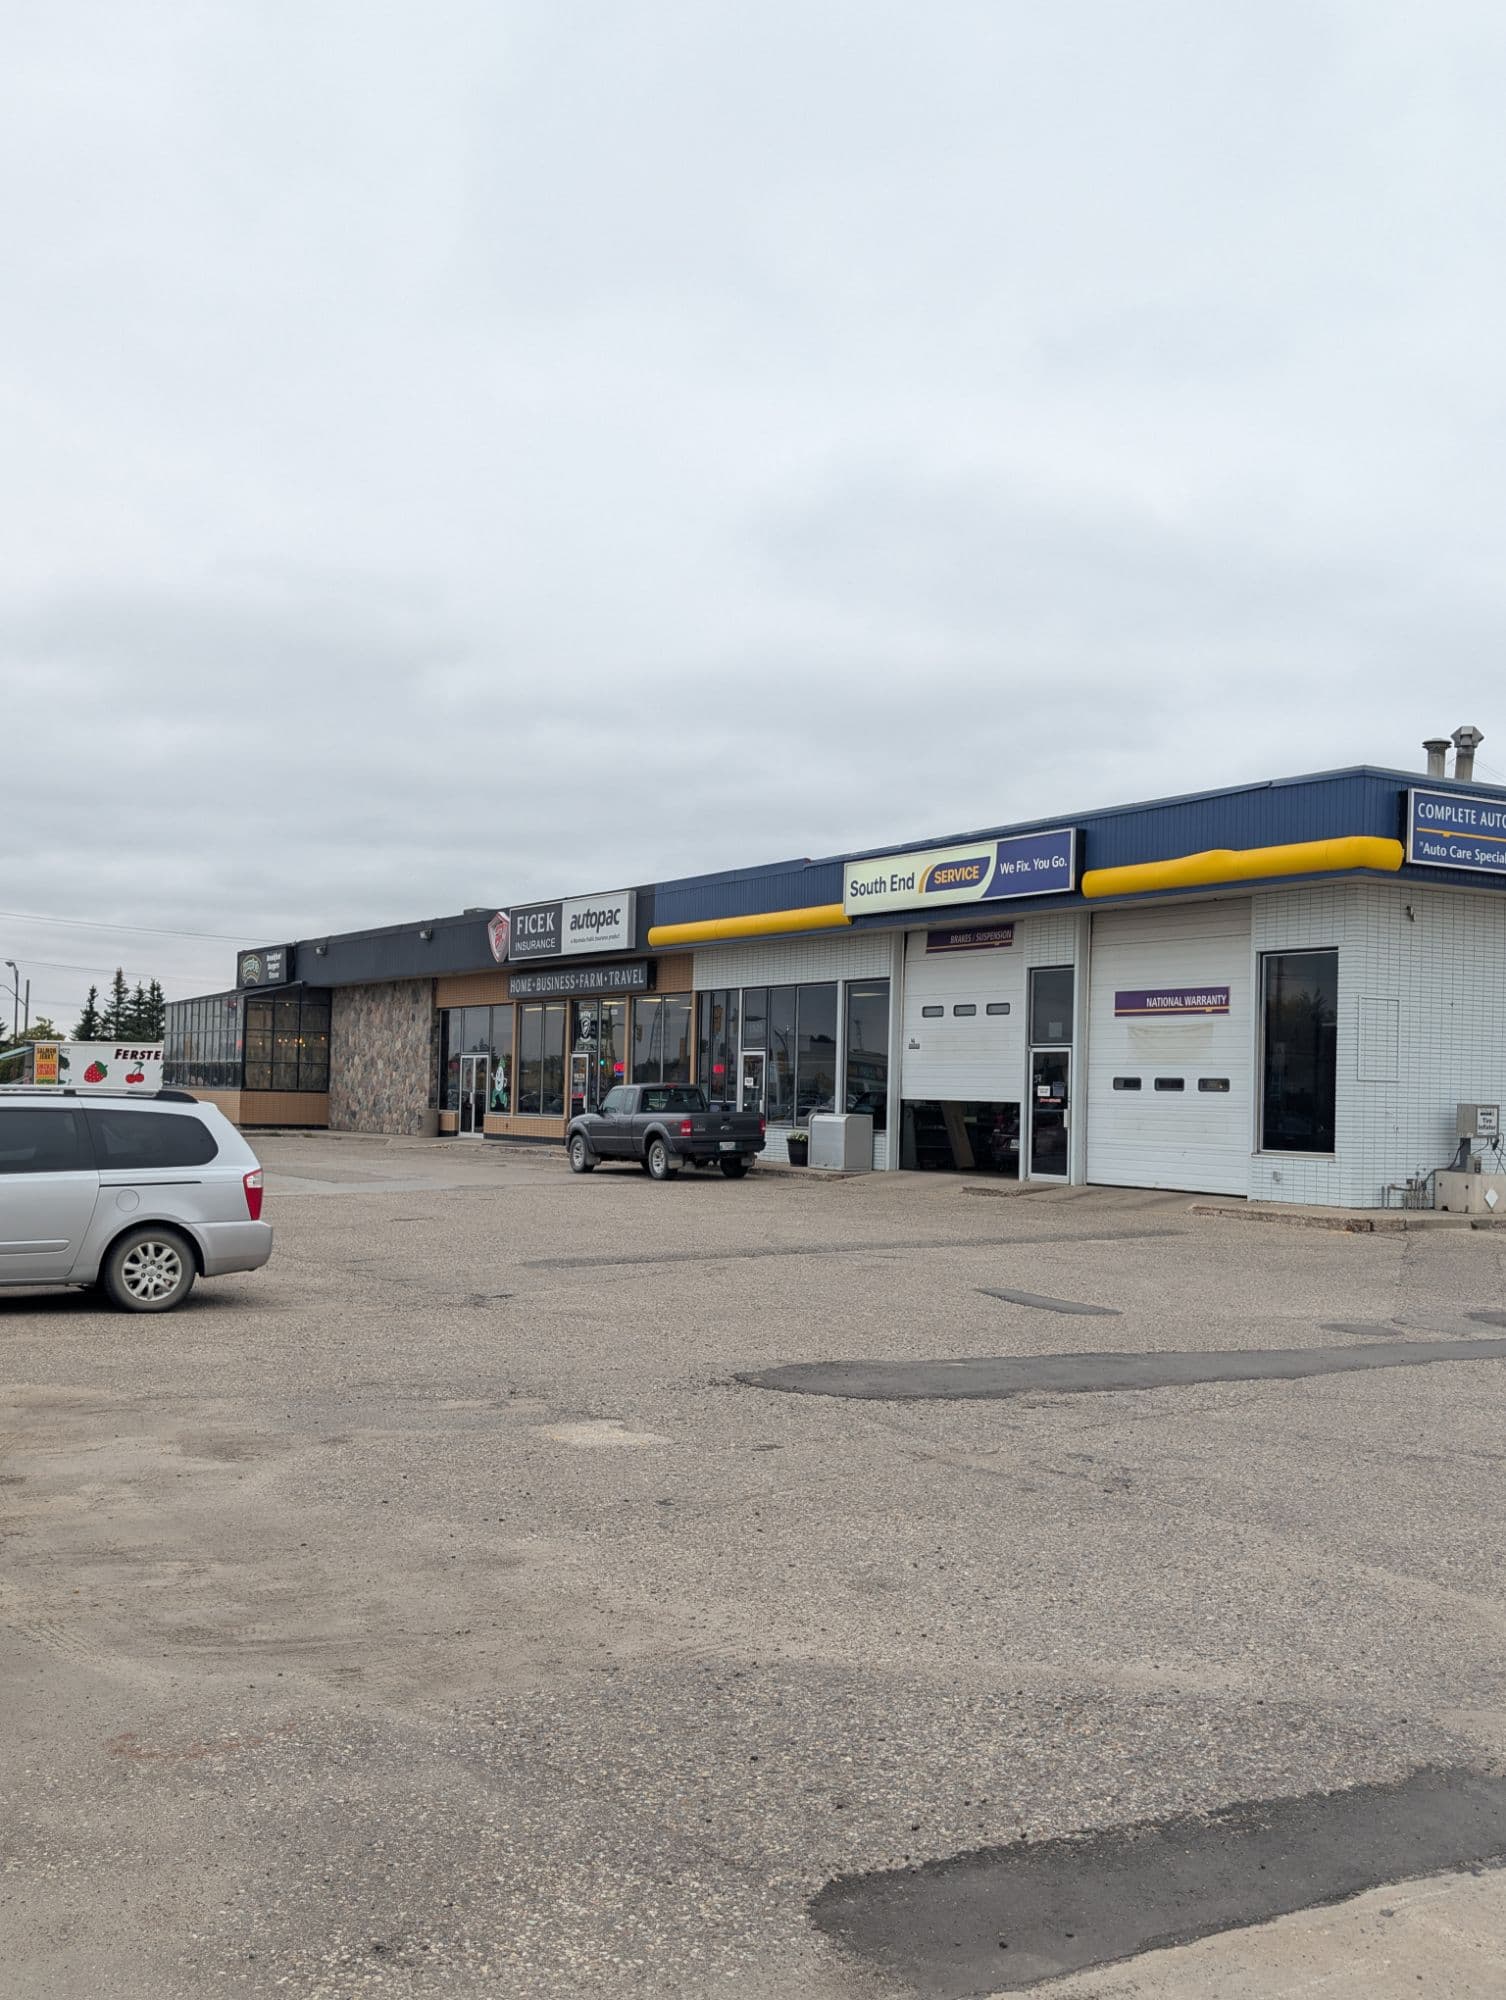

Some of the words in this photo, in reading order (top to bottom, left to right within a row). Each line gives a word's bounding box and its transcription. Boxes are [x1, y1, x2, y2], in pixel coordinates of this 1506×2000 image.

[1418, 802, 1477, 825] COMPLETE
[1449, 845, 1472, 860] Care
[934, 865, 980, 885] SERVICE
[1000, 861, 1015, 875] We
[1016, 859, 1031, 873] Fix.
[1033, 857, 1050, 870] You
[1051, 855, 1068, 868] Go.
[850, 876, 887, 898] South
[890, 872, 915, 892] End
[516, 911, 555, 936] FICEK
[570, 907, 622, 934] autopac
[514, 937, 556, 952] INSURANCE
[950, 932, 972, 944] BRAKES
[975, 929, 1012, 941] SUSPENSION
[510, 977, 532, 993] HOME
[536, 975, 575, 991] BUSINESS
[579, 972, 603, 988] FARM
[609, 968, 644, 985] TRAVEL
[1146, 996, 1183, 1008] NATIONAL
[1184, 994, 1227, 1006] WARRANTY
[114, 1048, 164, 1060] FERSTE
